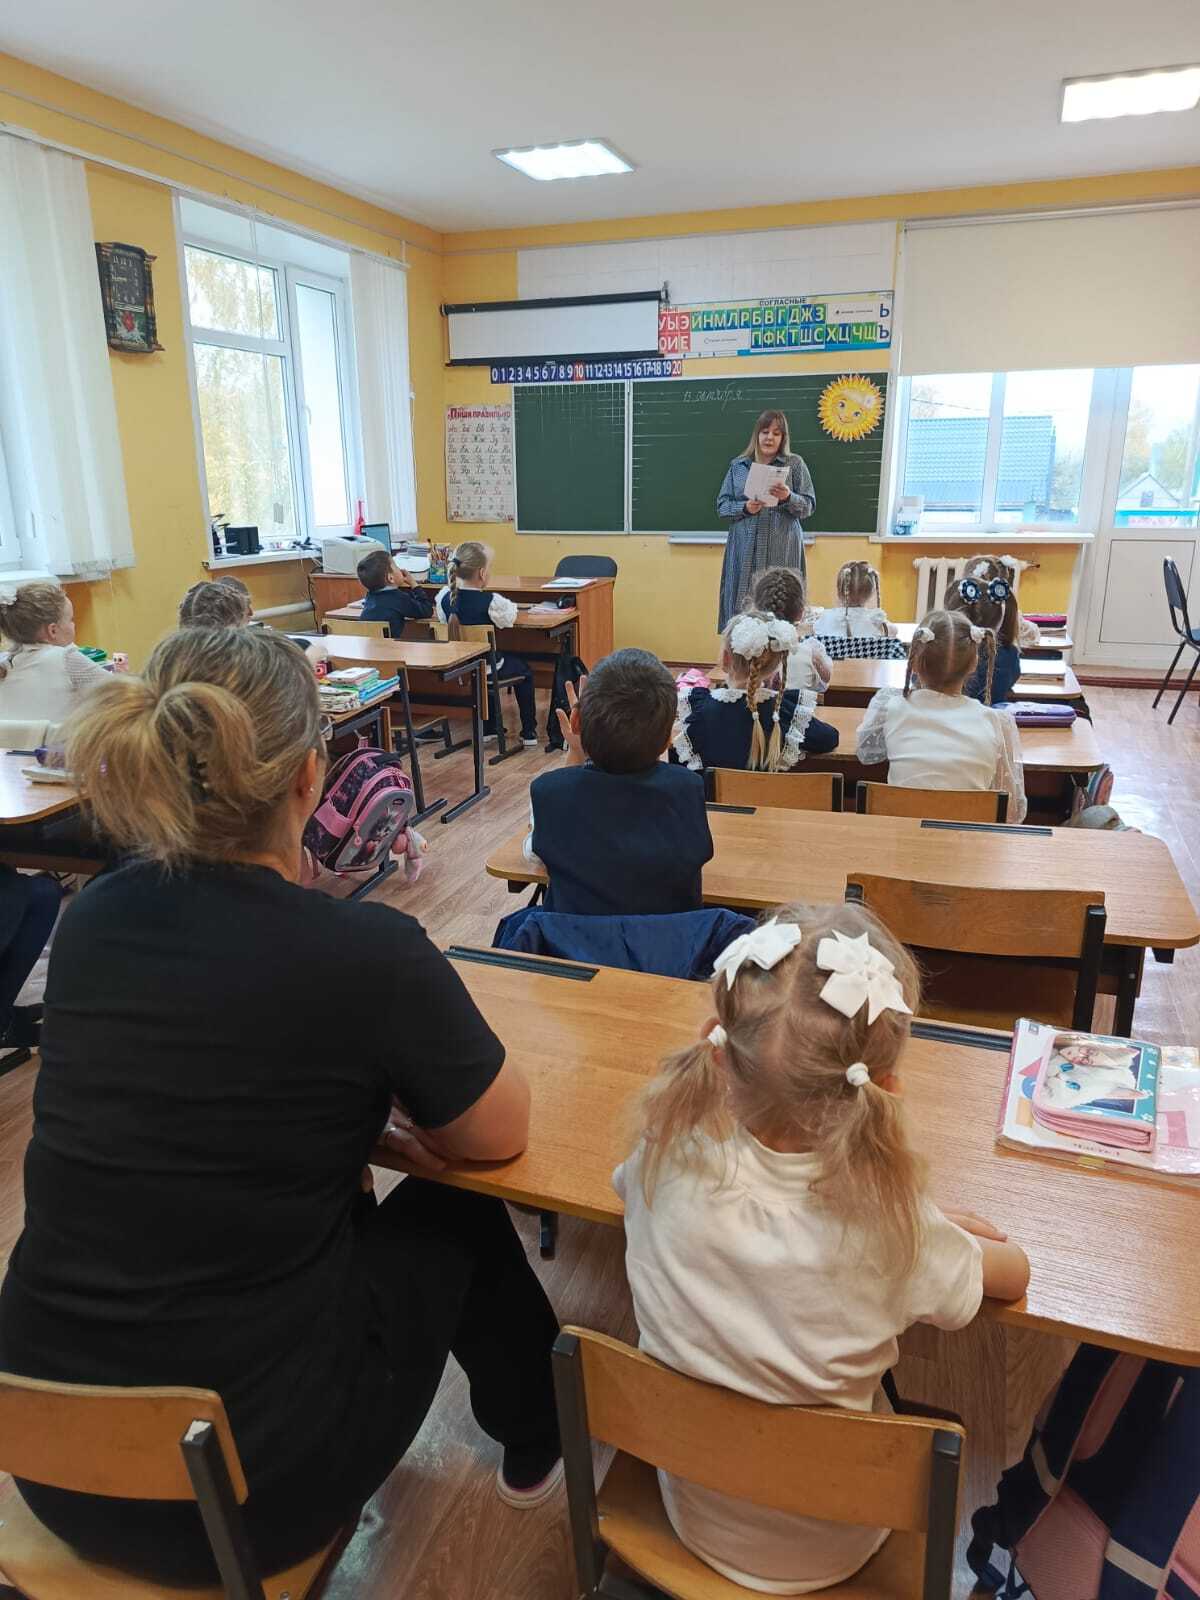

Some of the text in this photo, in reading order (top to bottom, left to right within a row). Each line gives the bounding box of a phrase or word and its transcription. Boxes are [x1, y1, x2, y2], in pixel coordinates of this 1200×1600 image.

[760, 296, 807, 306] СОГЛАСНЫЕ
[492, 368, 498, 381] 0
[509, 367, 515, 381] 2
[517, 367, 523, 380] 3
[525, 367, 532, 380] 4
[534, 366, 540, 380] 5
[542, 366, 549, 380] 6
[551, 366, 557, 379] 7
[559, 365, 565, 379] 8
[567, 365, 573, 378] 9
[575, 364, 584, 378] 10
[586, 364, 593, 378] 11
[595, 364, 603, 378] 12
[604, 363, 613, 377] 13
[614, 363, 623, 377] 14
[623, 362, 632, 377] 15
[633, 362, 642, 376] 16
[643, 361, 652, 376] 17
[653, 361, 662, 376] 18
[663, 361, 672, 375] 19
[672, 360, 681, 375] 20
